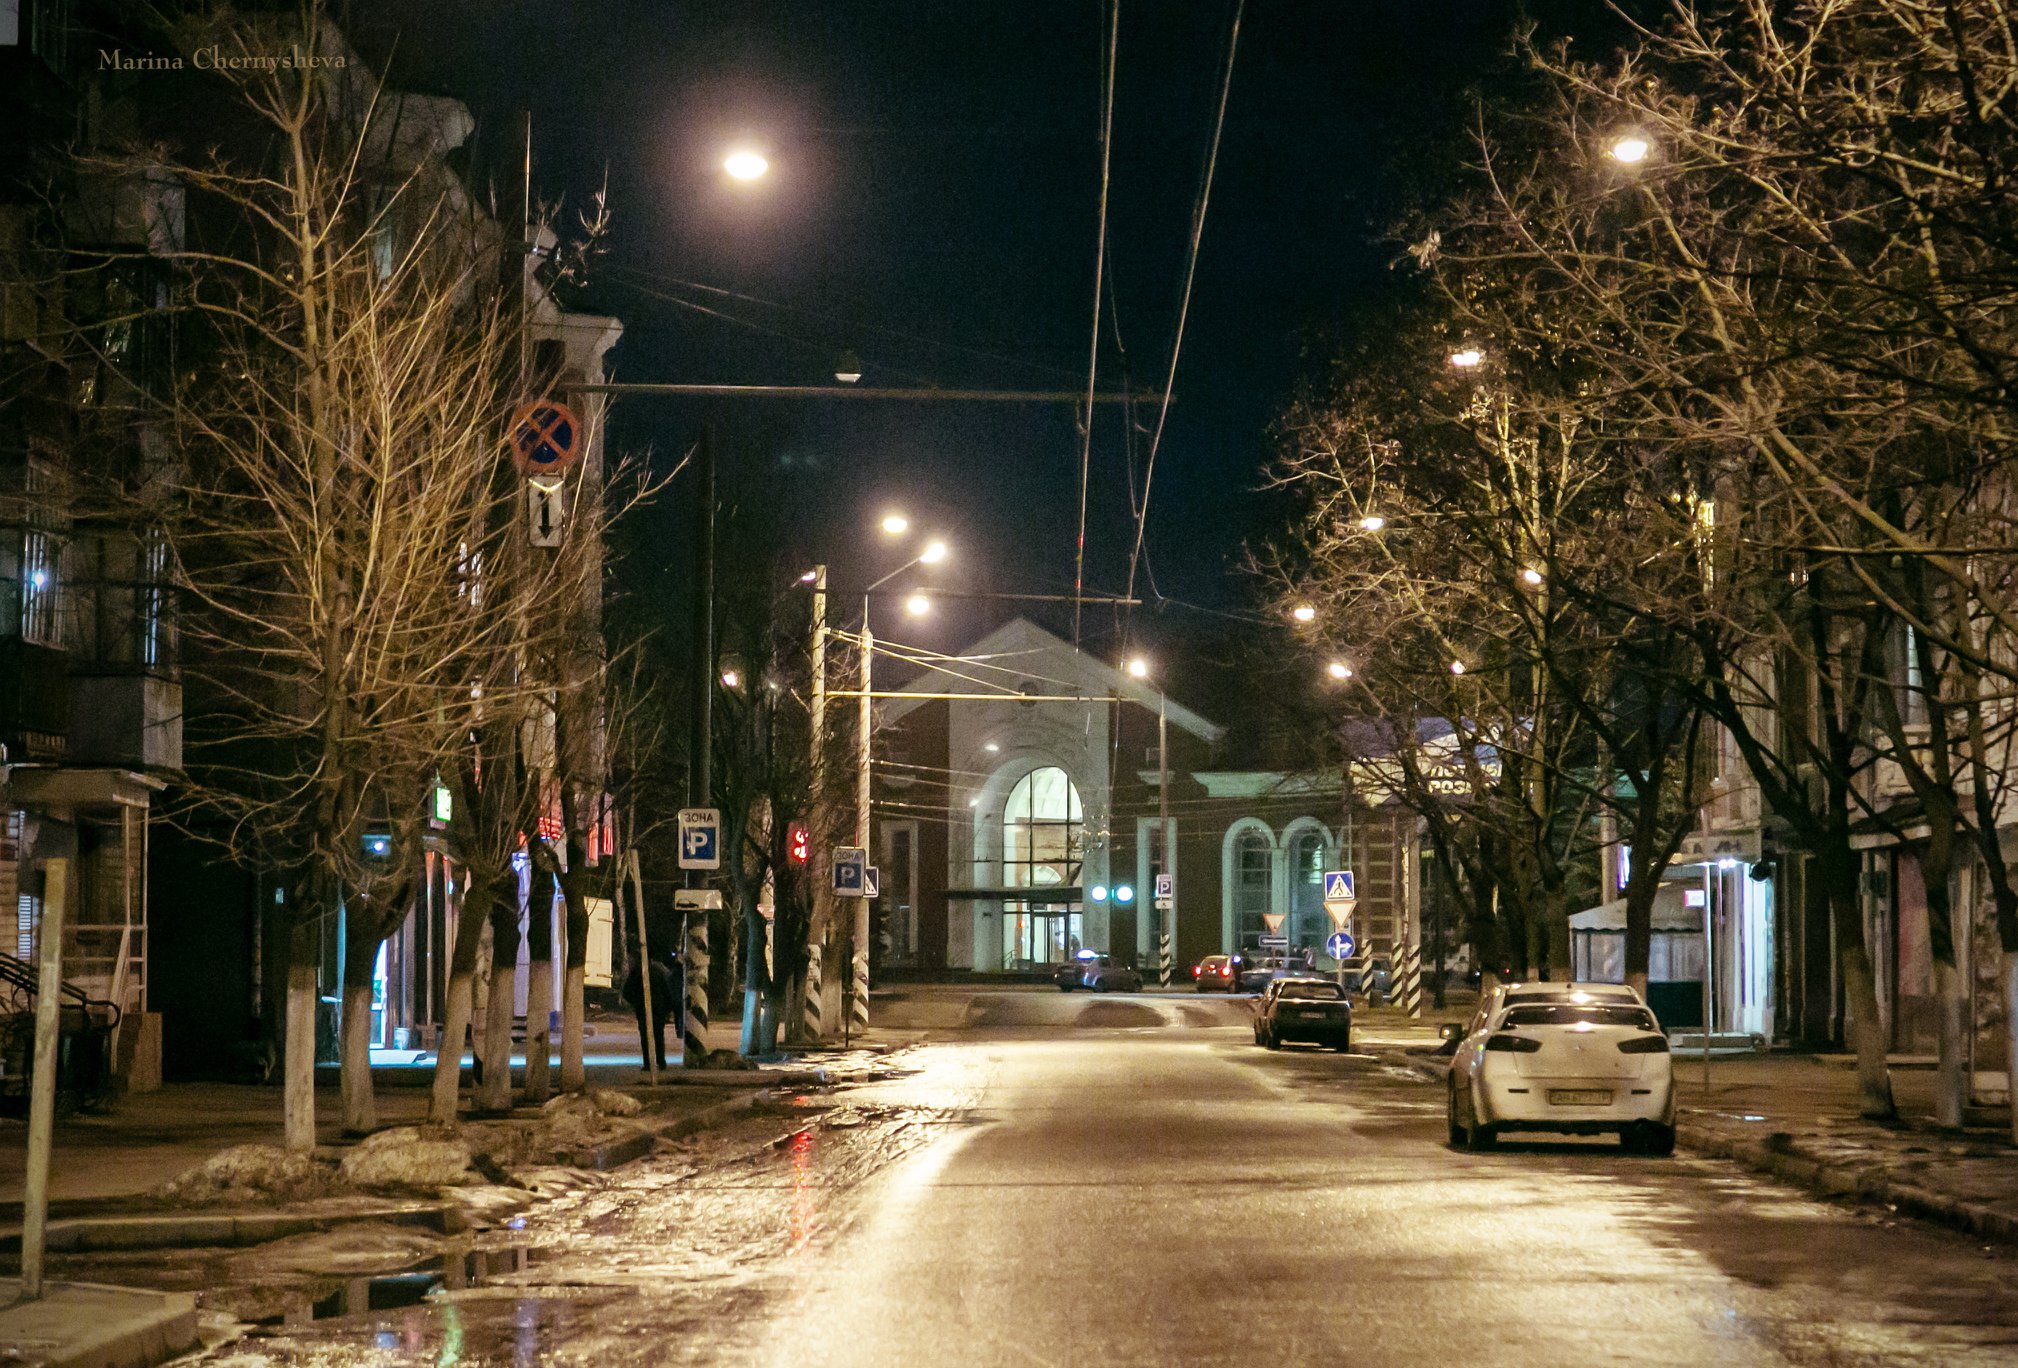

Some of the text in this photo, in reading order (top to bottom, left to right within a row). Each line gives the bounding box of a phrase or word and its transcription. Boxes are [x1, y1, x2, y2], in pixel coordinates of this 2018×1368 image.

[684, 812, 714, 823] ЗОНА
[690, 831, 708, 856] P
[841, 866, 855, 886] P
[1160, 881, 1170, 894] P
